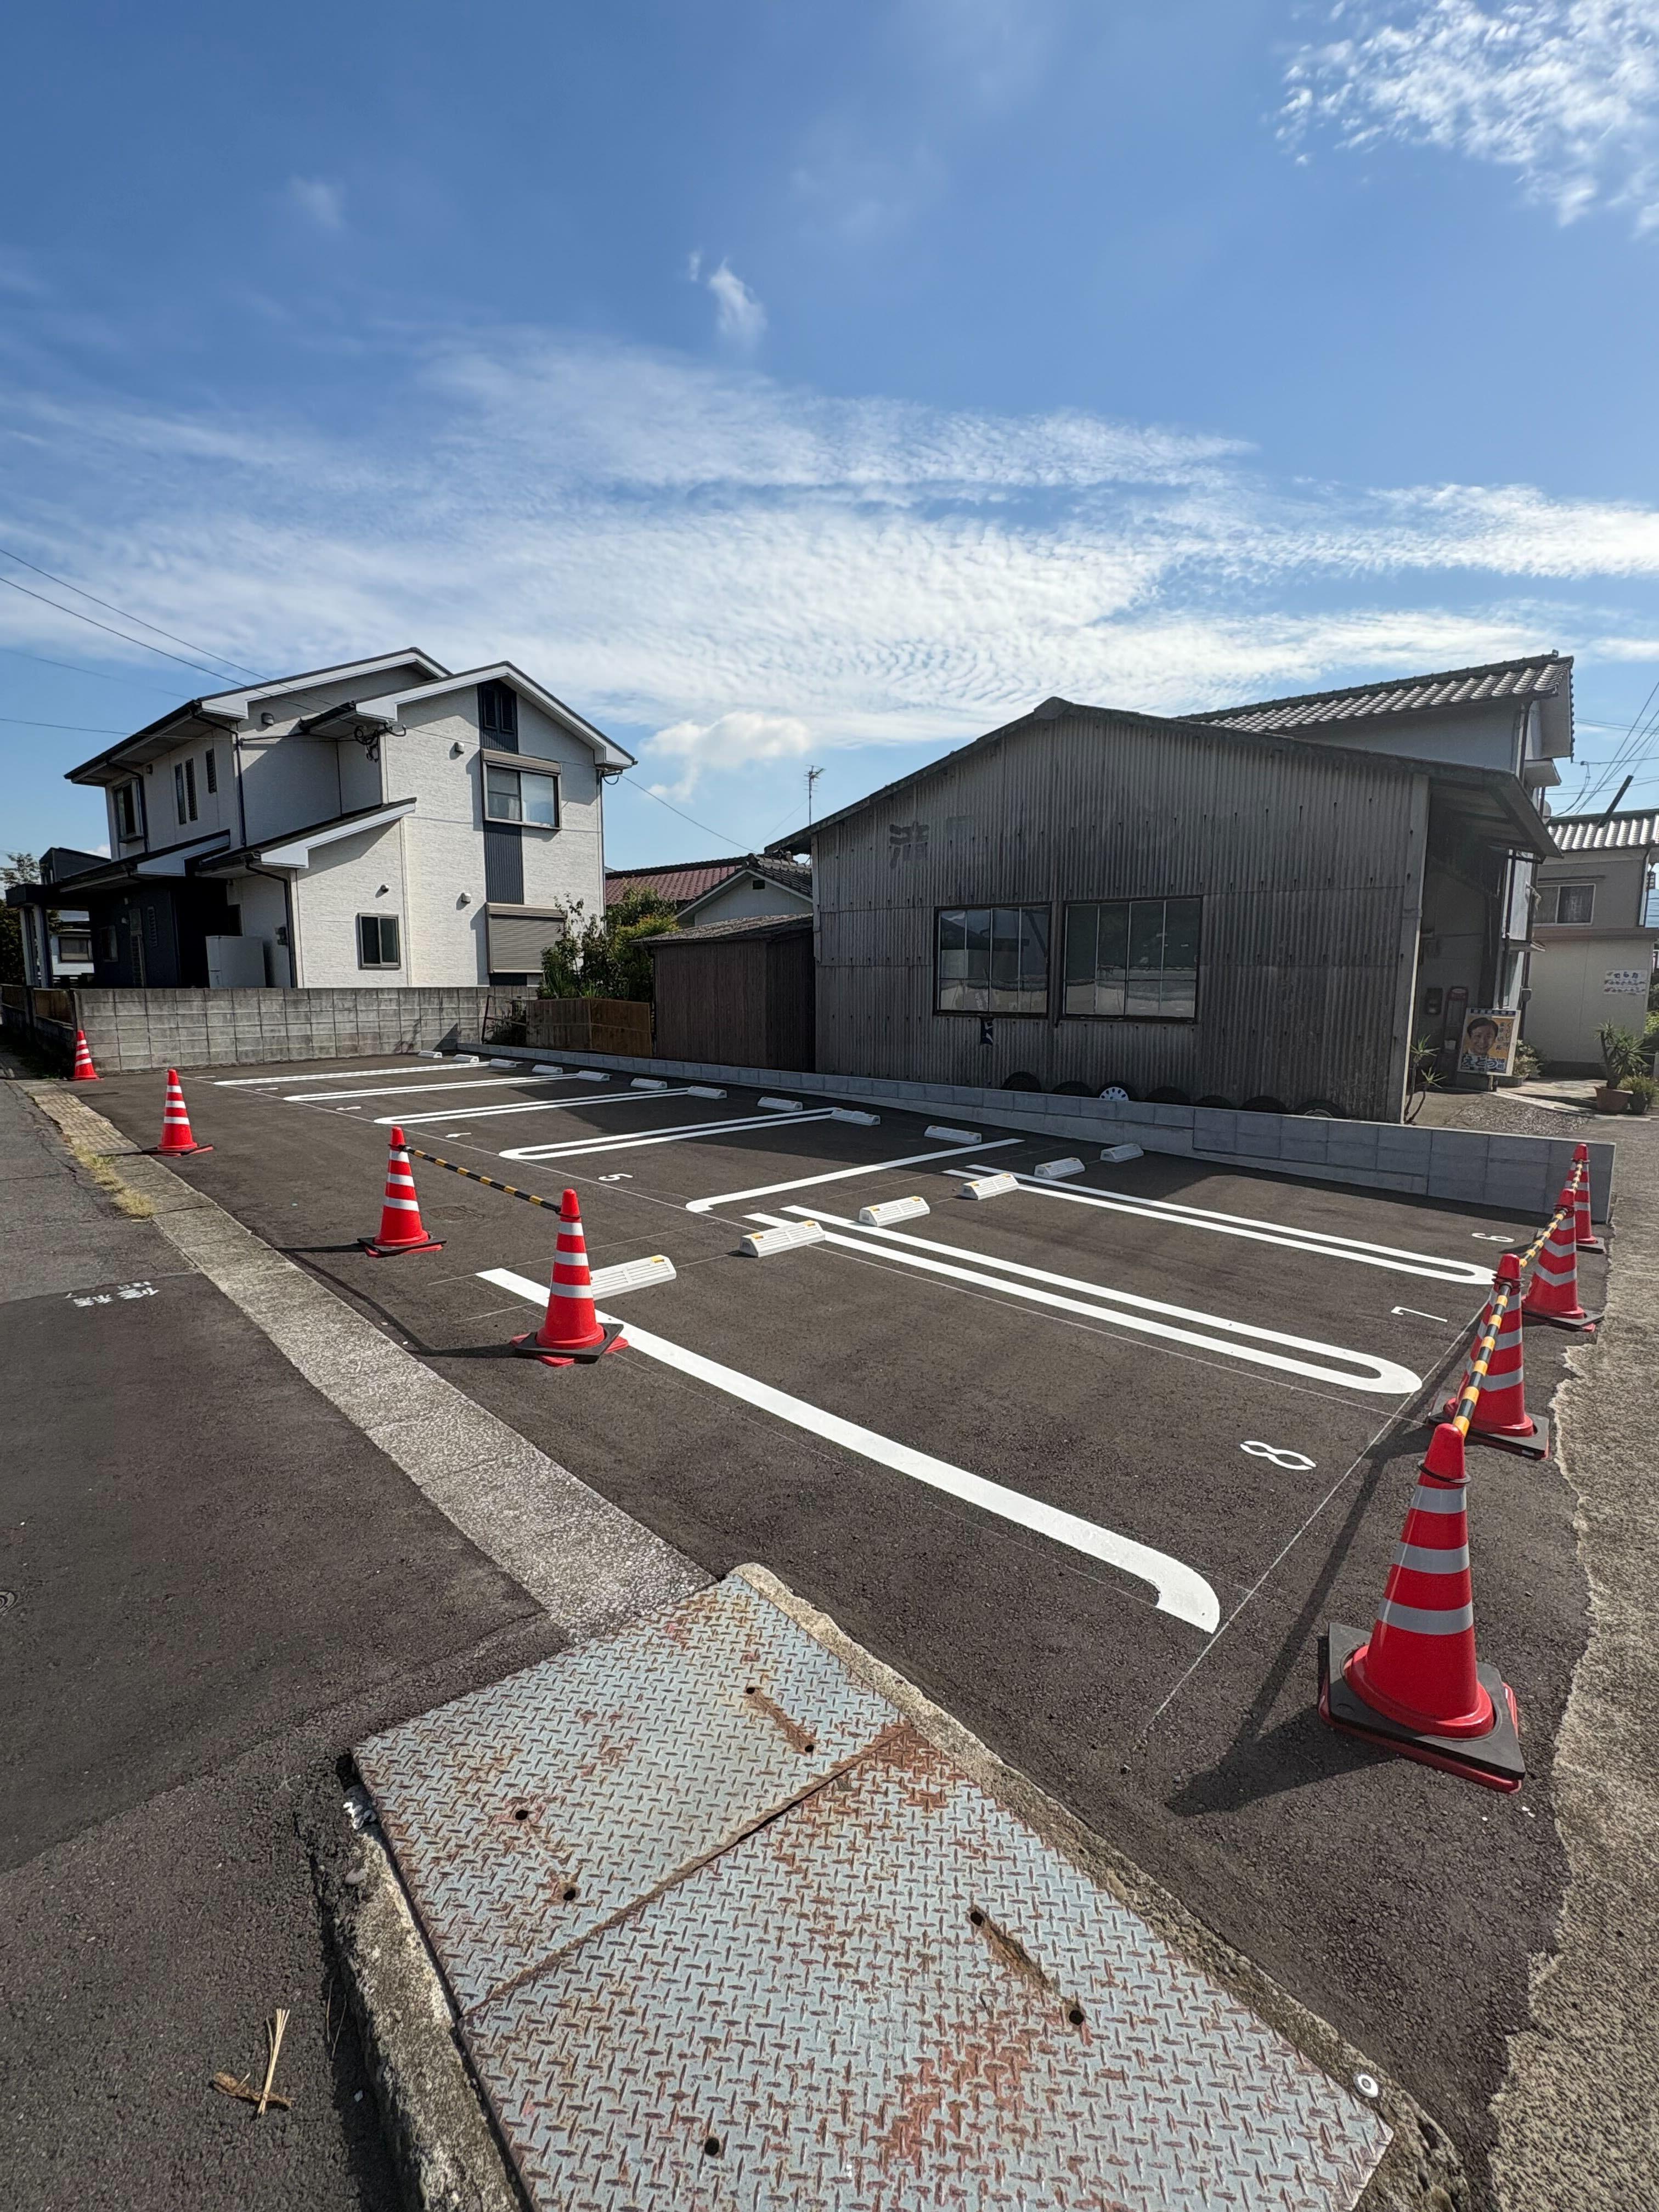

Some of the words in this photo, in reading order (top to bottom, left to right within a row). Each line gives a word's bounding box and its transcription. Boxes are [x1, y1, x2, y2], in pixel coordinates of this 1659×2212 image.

[1471, 1233, 1515, 1243] 6
[1391, 1306, 1447, 1322] 7
[1240, 1441, 1316, 1470] 8
